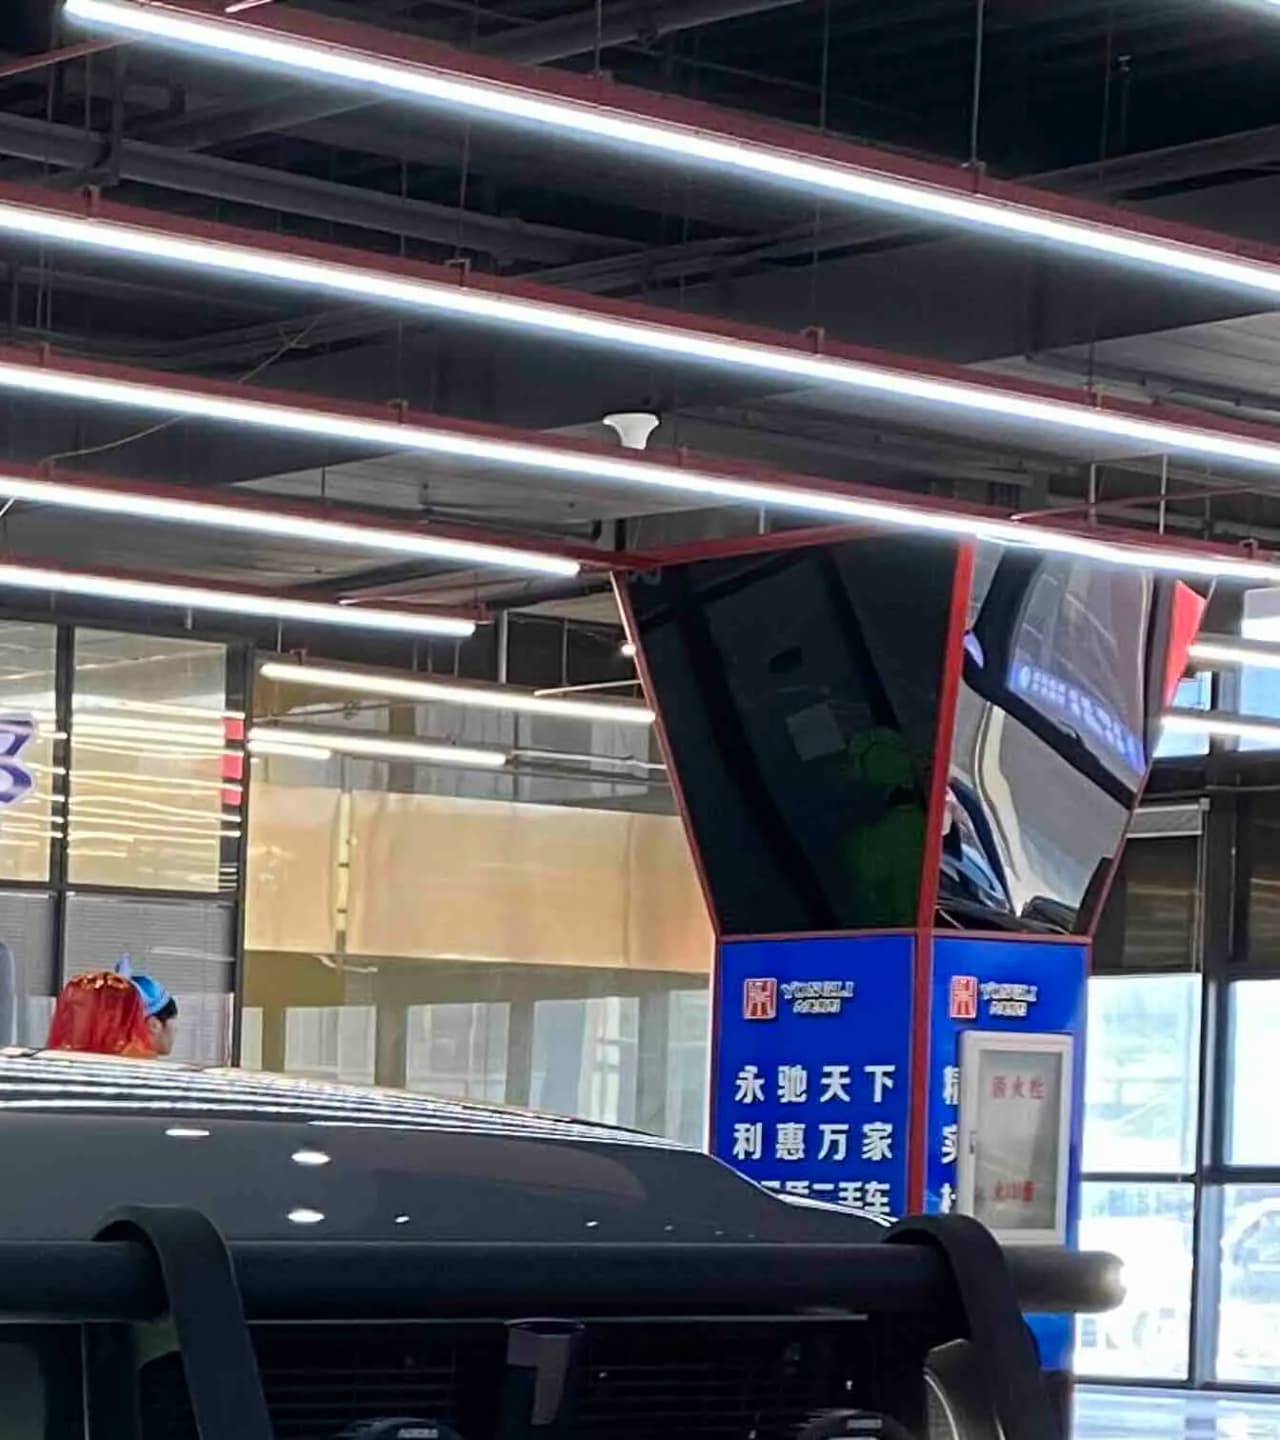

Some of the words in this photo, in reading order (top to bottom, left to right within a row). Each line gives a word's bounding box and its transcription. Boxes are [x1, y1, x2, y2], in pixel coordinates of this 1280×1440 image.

[734, 1064, 896, 1104] 永驰天下
[732, 1121, 894, 1161] 利惠万家
